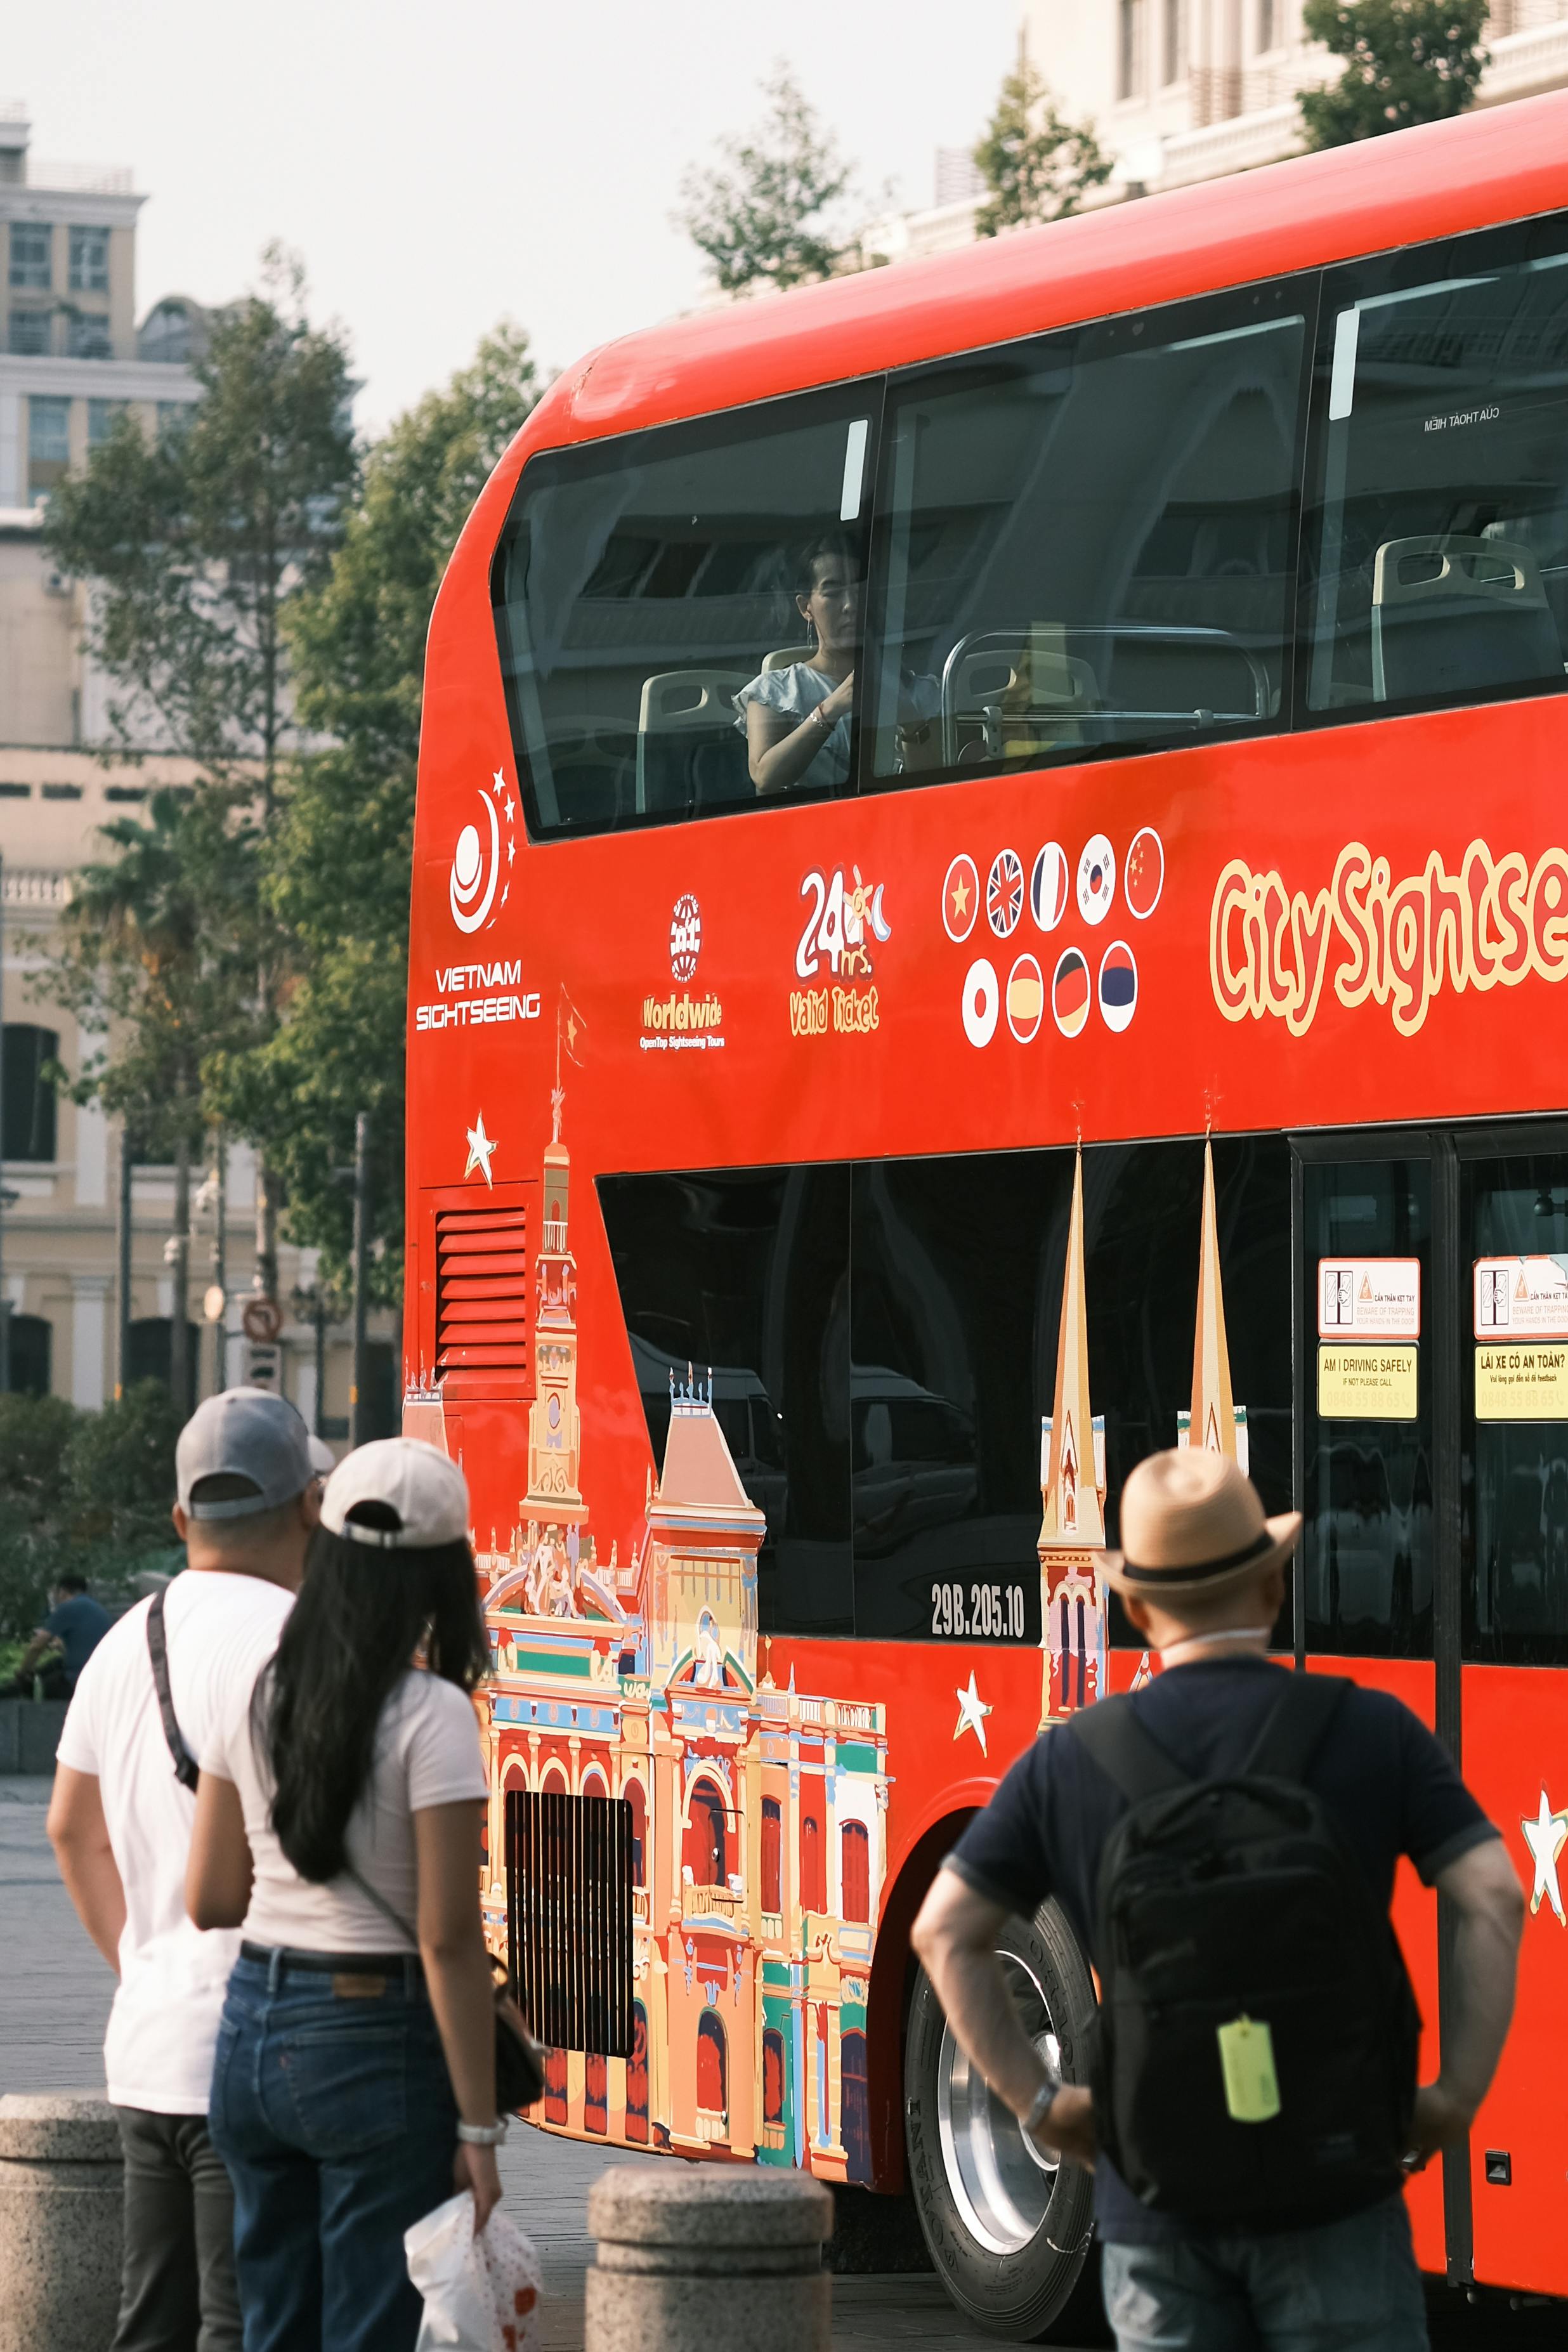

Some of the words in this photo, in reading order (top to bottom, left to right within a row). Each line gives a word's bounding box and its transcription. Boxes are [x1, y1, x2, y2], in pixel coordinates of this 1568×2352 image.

[435, 959, 521, 993] VIETNAM
[415, 993, 540, 1031] SIGHTSEEING
[643, 993, 722, 1030] Worldwide
[789, 987, 828, 1037] Valid
[831, 985, 880, 1033] Ticket
[669, 1035, 706, 1050] Sightseeing
[707, 1035, 725, 1047] Tours
[1356, 1307, 1378, 1316] BEWARE
[1380, 1307, 1387, 1316] OF
[1388, 1307, 1414, 1316] TRAPPING
[1512, 1305, 1534, 1315] BEWARE
[1535, 1305, 1543, 1314] OF
[1324, 1359, 1336, 1371] AM
[1343, 1359, 1378, 1372] DRIVING
[1380, 1359, 1412, 1373] SAFELY
[1496, 1355, 1506, 1369] XE
[1509, 1351, 1520, 1369] CÓ
[1523, 1355, 1534, 1369] AN
[1349, 1378, 1359, 1386] NOT
[1380, 1378, 1392, 1387] CALL
[931, 1583, 1024, 1638] 29B.205.10
